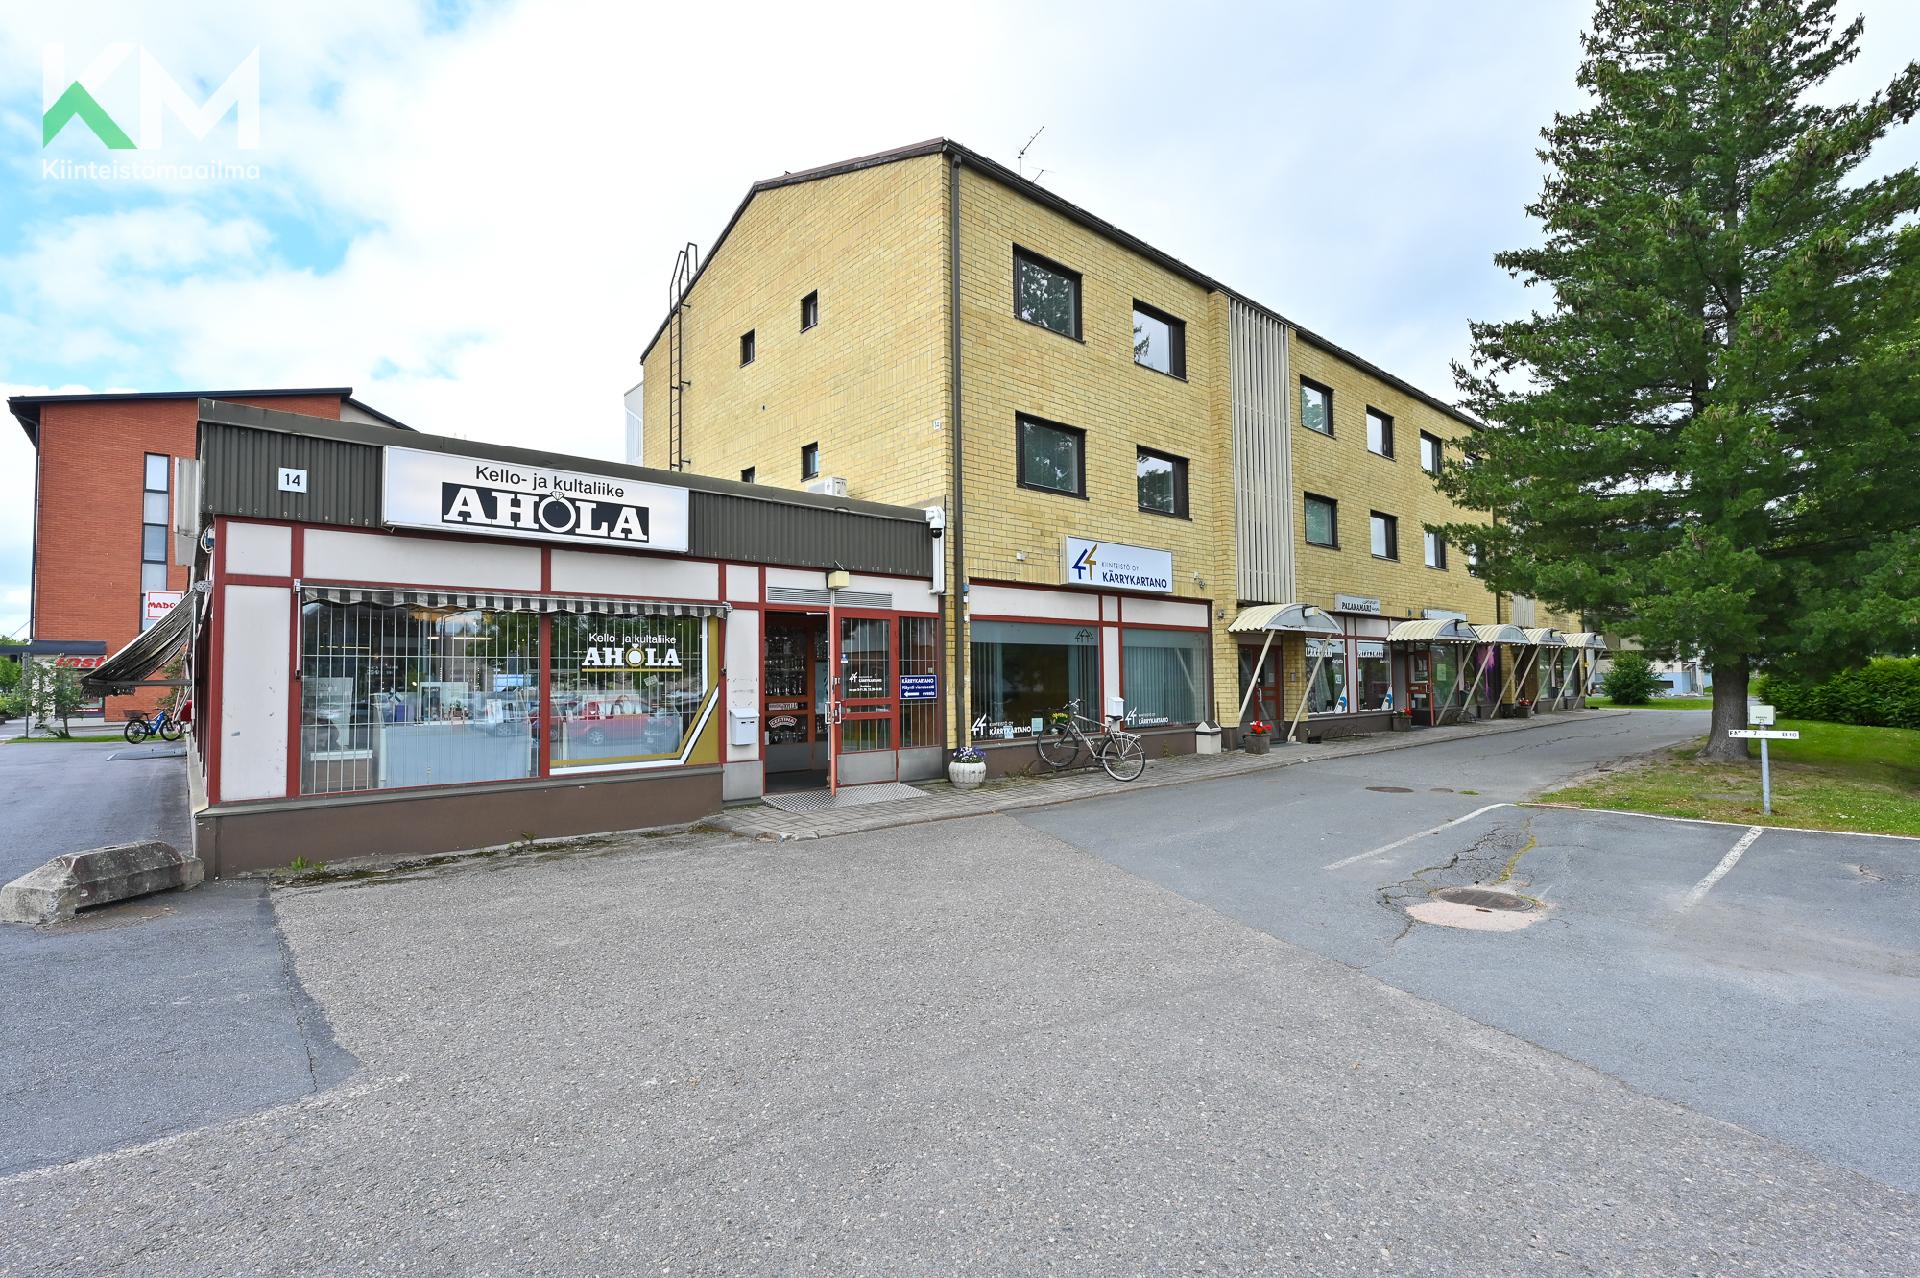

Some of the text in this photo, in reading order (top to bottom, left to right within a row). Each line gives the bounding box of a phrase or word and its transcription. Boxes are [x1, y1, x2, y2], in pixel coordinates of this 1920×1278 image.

[285, 473, 301, 486] 14
[475, 465, 625, 498] Kello- ja kultaliike
[443, 487, 648, 541] AHOLA
[1102, 569, 1167, 589] KÄRRYKARTANO
[621, 634, 632, 646] ja
[634, 634, 677, 644] kultaliike
[581, 646, 682, 667] AHOLA
